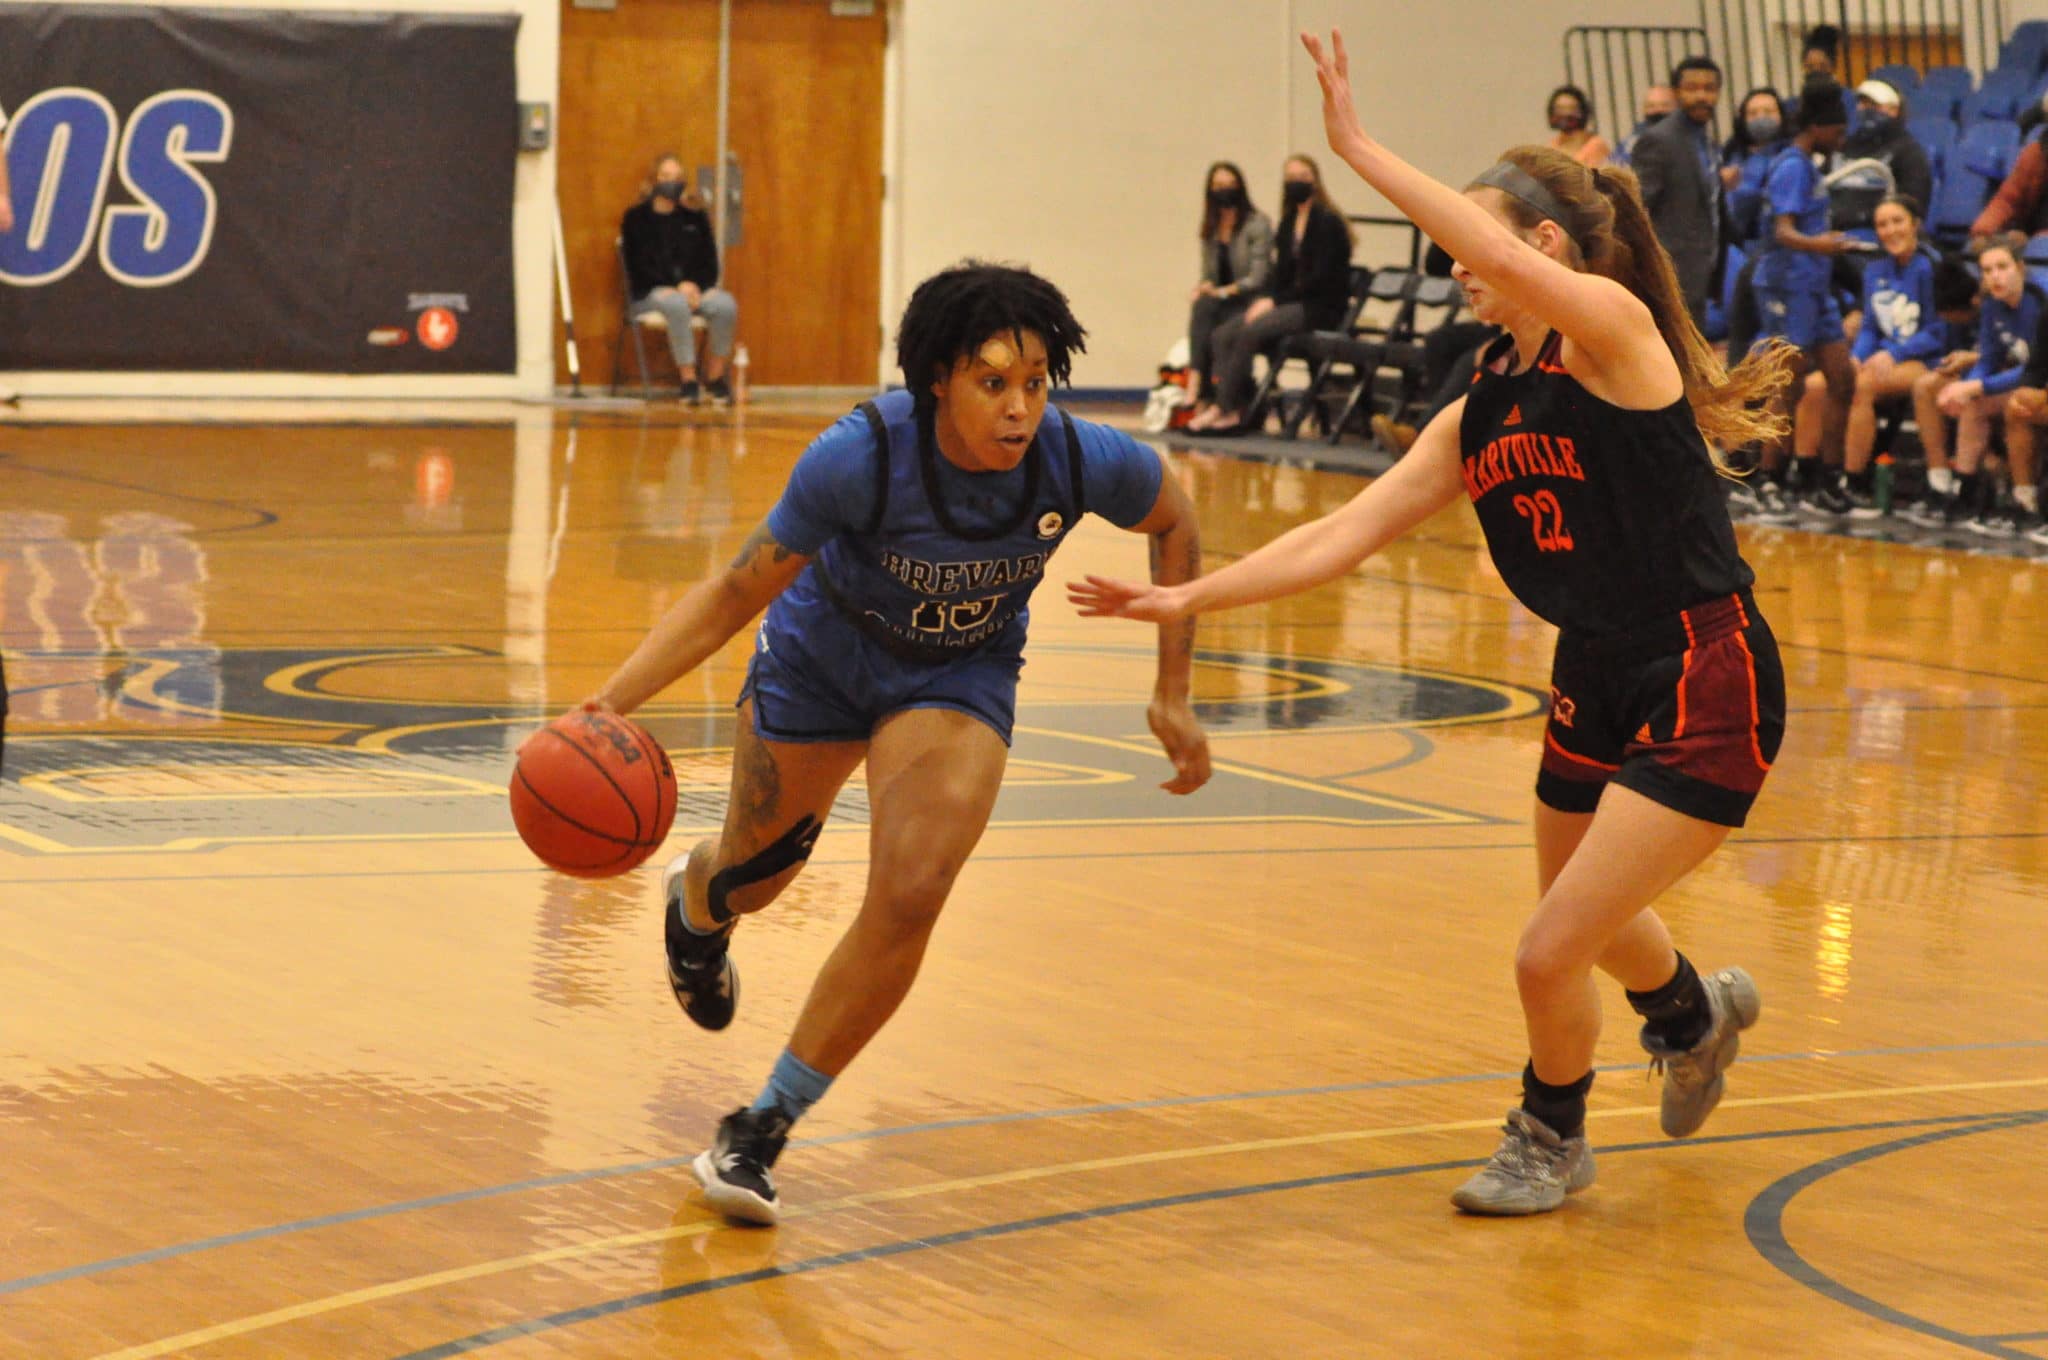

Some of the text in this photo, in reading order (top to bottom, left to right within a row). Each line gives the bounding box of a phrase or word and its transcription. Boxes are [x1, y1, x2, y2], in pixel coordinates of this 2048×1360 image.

[1462, 432, 1585, 503] MARYVILLE
[1512, 489, 1574, 551] 22
[881, 551, 1052, 595] BREVAR
